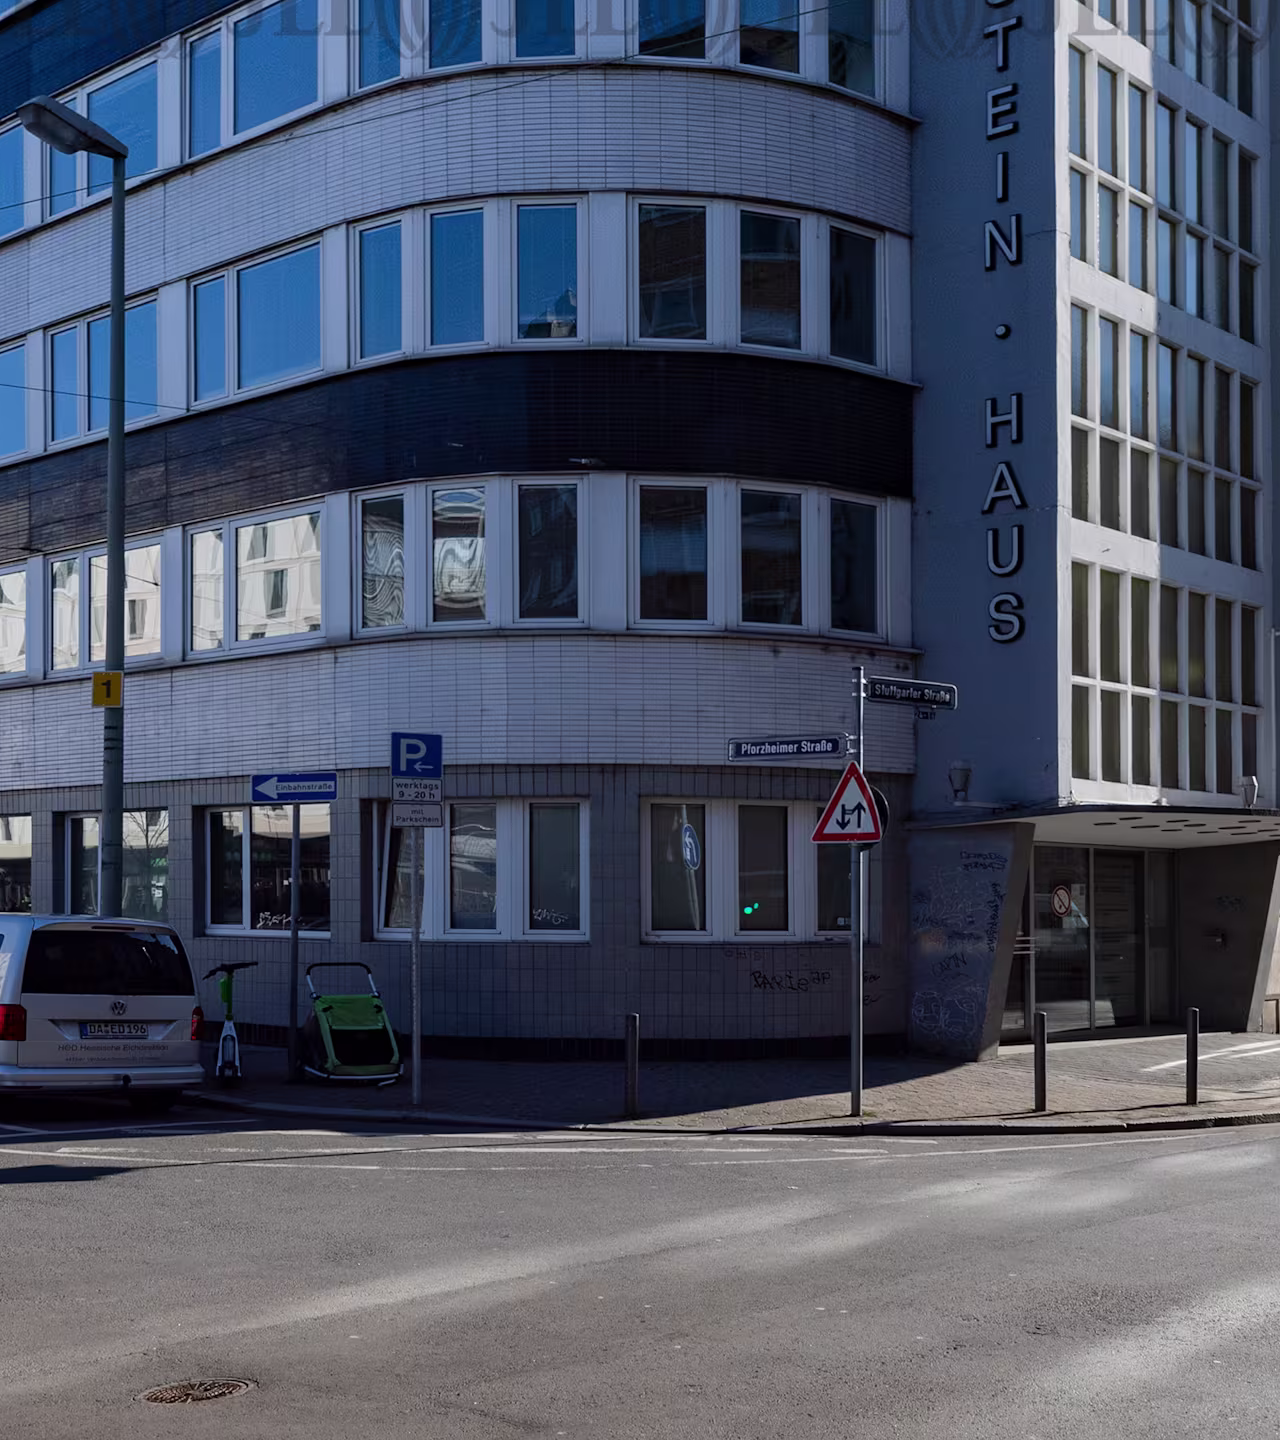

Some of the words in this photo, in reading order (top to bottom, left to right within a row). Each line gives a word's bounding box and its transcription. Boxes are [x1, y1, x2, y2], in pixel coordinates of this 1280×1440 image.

[981, 392, 1028, 643] HAUS
[101, 679, 111, 698] 1
[874, 684, 922, 700] Stuttgarter
[923, 688, 951, 703] Straße
[399, 738, 427, 772] P
[741, 741, 798, 755] Pforzheimer
[801, 740, 833, 753] Straße
[275, 782, 333, 792] Einbahnstraße
[395, 781, 439, 792] werktags
[398, 791, 405, 799] 9
[414, 791, 426, 799] 20
[428, 791, 435, 799] h
[395, 815, 440, 824] Parkschein
